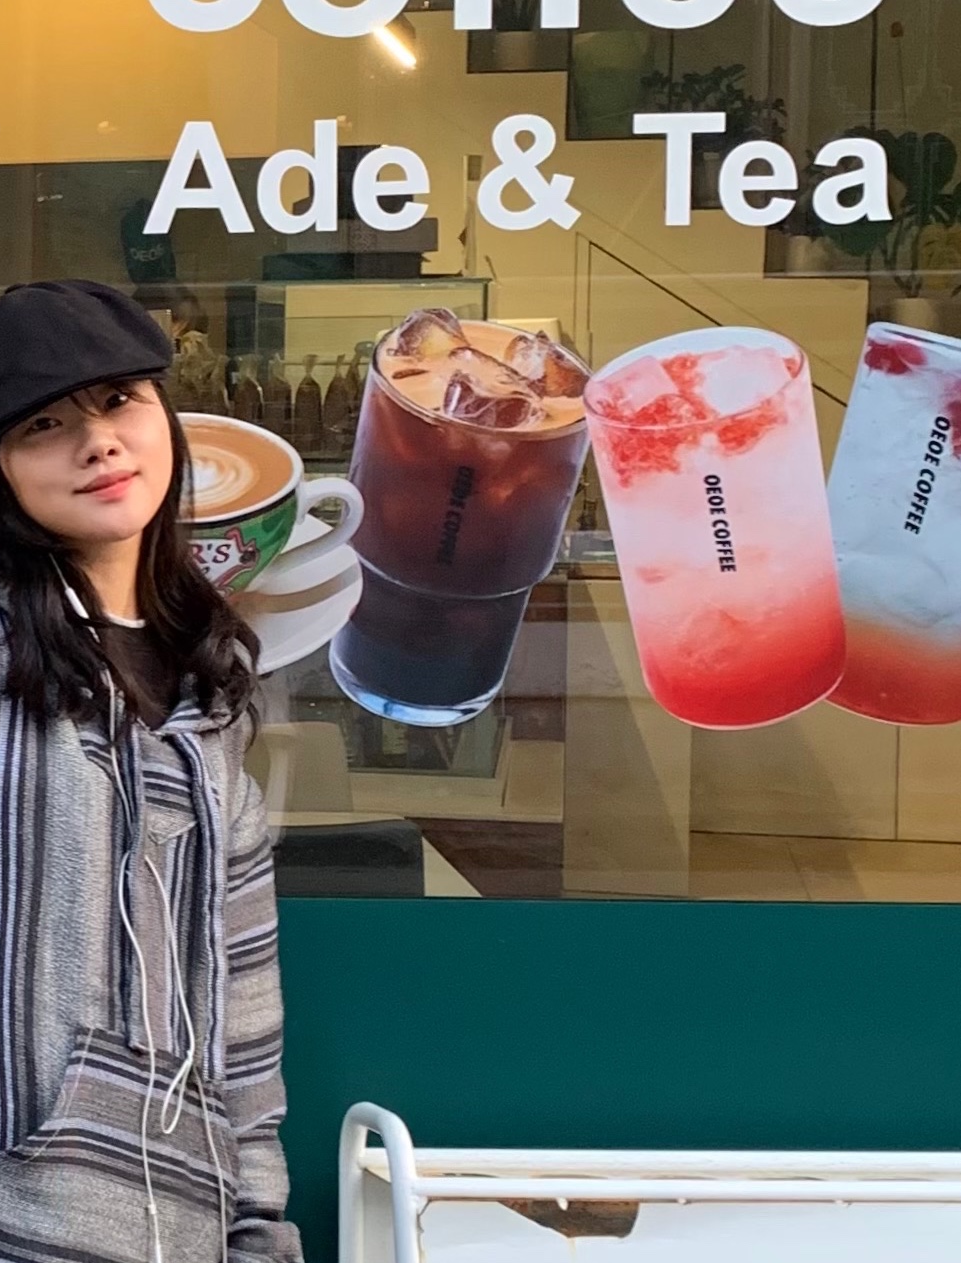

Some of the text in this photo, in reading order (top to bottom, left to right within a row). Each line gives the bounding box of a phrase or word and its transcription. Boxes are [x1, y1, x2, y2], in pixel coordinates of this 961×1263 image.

[143, 112, 893, 234] Ade & Tea
[703, 474, 737, 573] OEOE COFFEE
[904, 416, 951, 535] OEOE COFFEE
